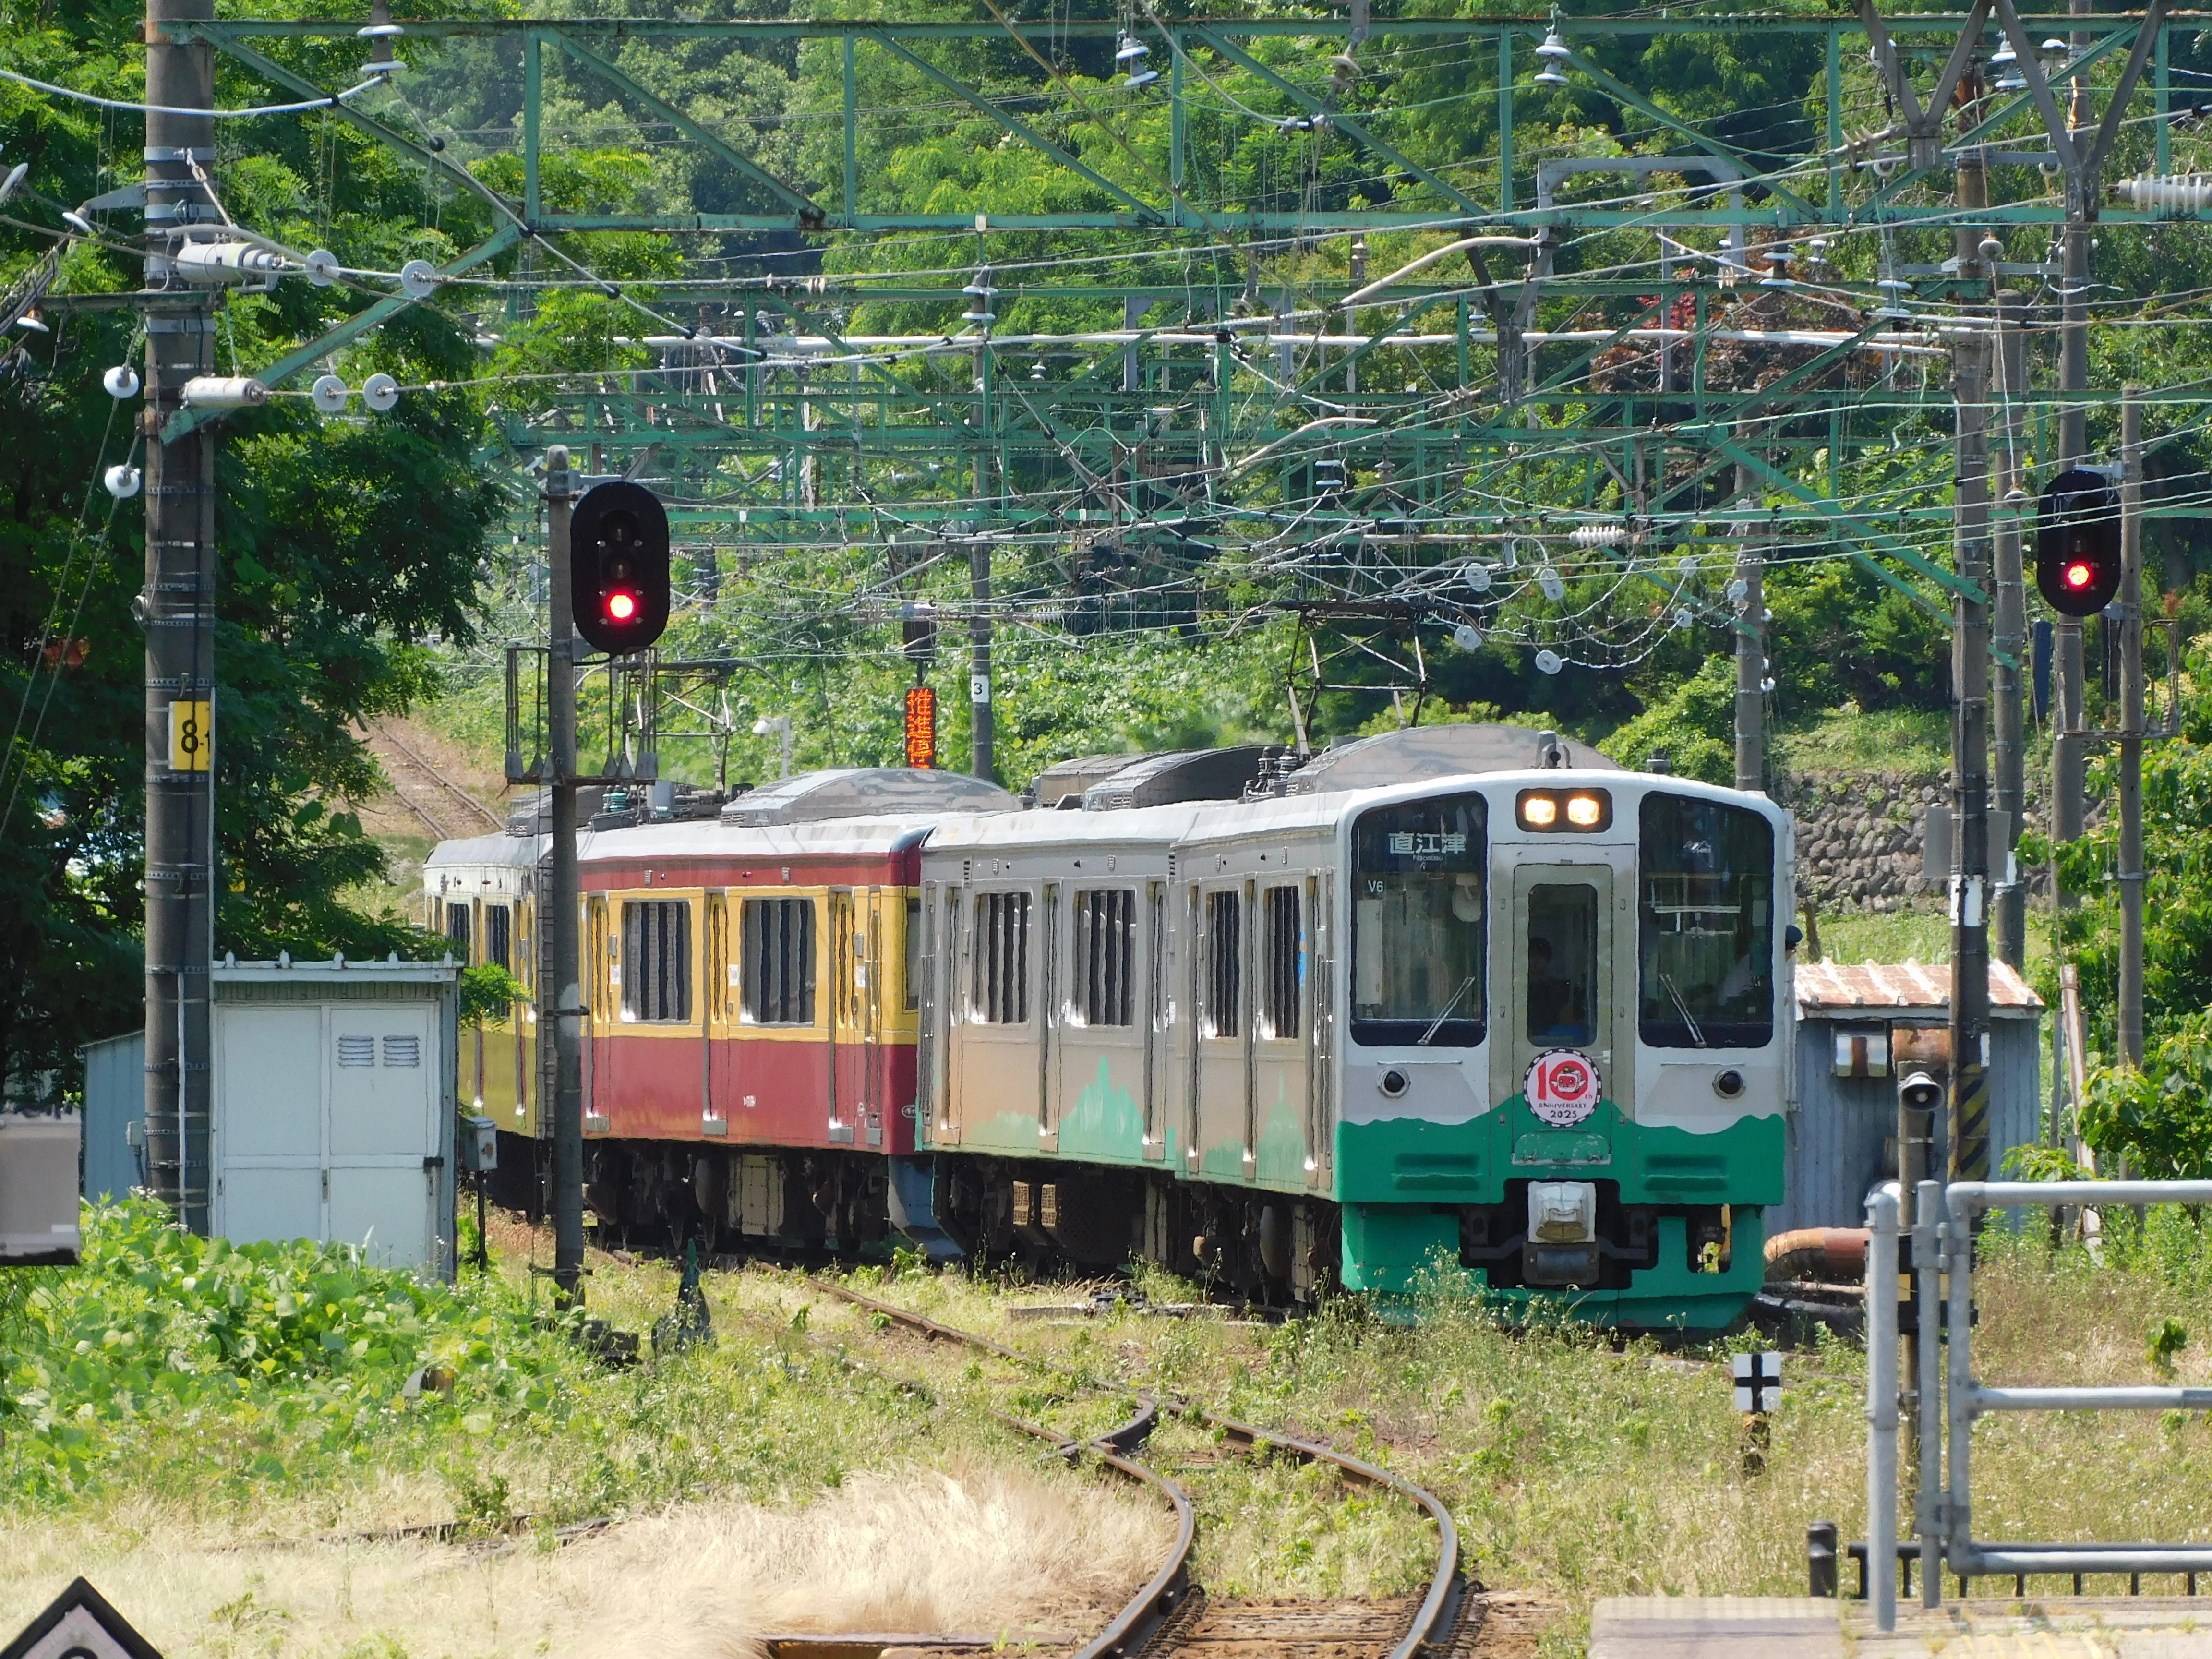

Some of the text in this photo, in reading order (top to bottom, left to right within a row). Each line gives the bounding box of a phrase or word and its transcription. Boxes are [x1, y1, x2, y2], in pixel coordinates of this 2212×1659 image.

[974, 683, 982, 694] 3
[907, 688, 932, 769] 推進停
[1388, 831, 1466, 854] 直江津
[1368, 879, 1383, 893] V6
[1550, 1110, 1577, 1118] 2025
